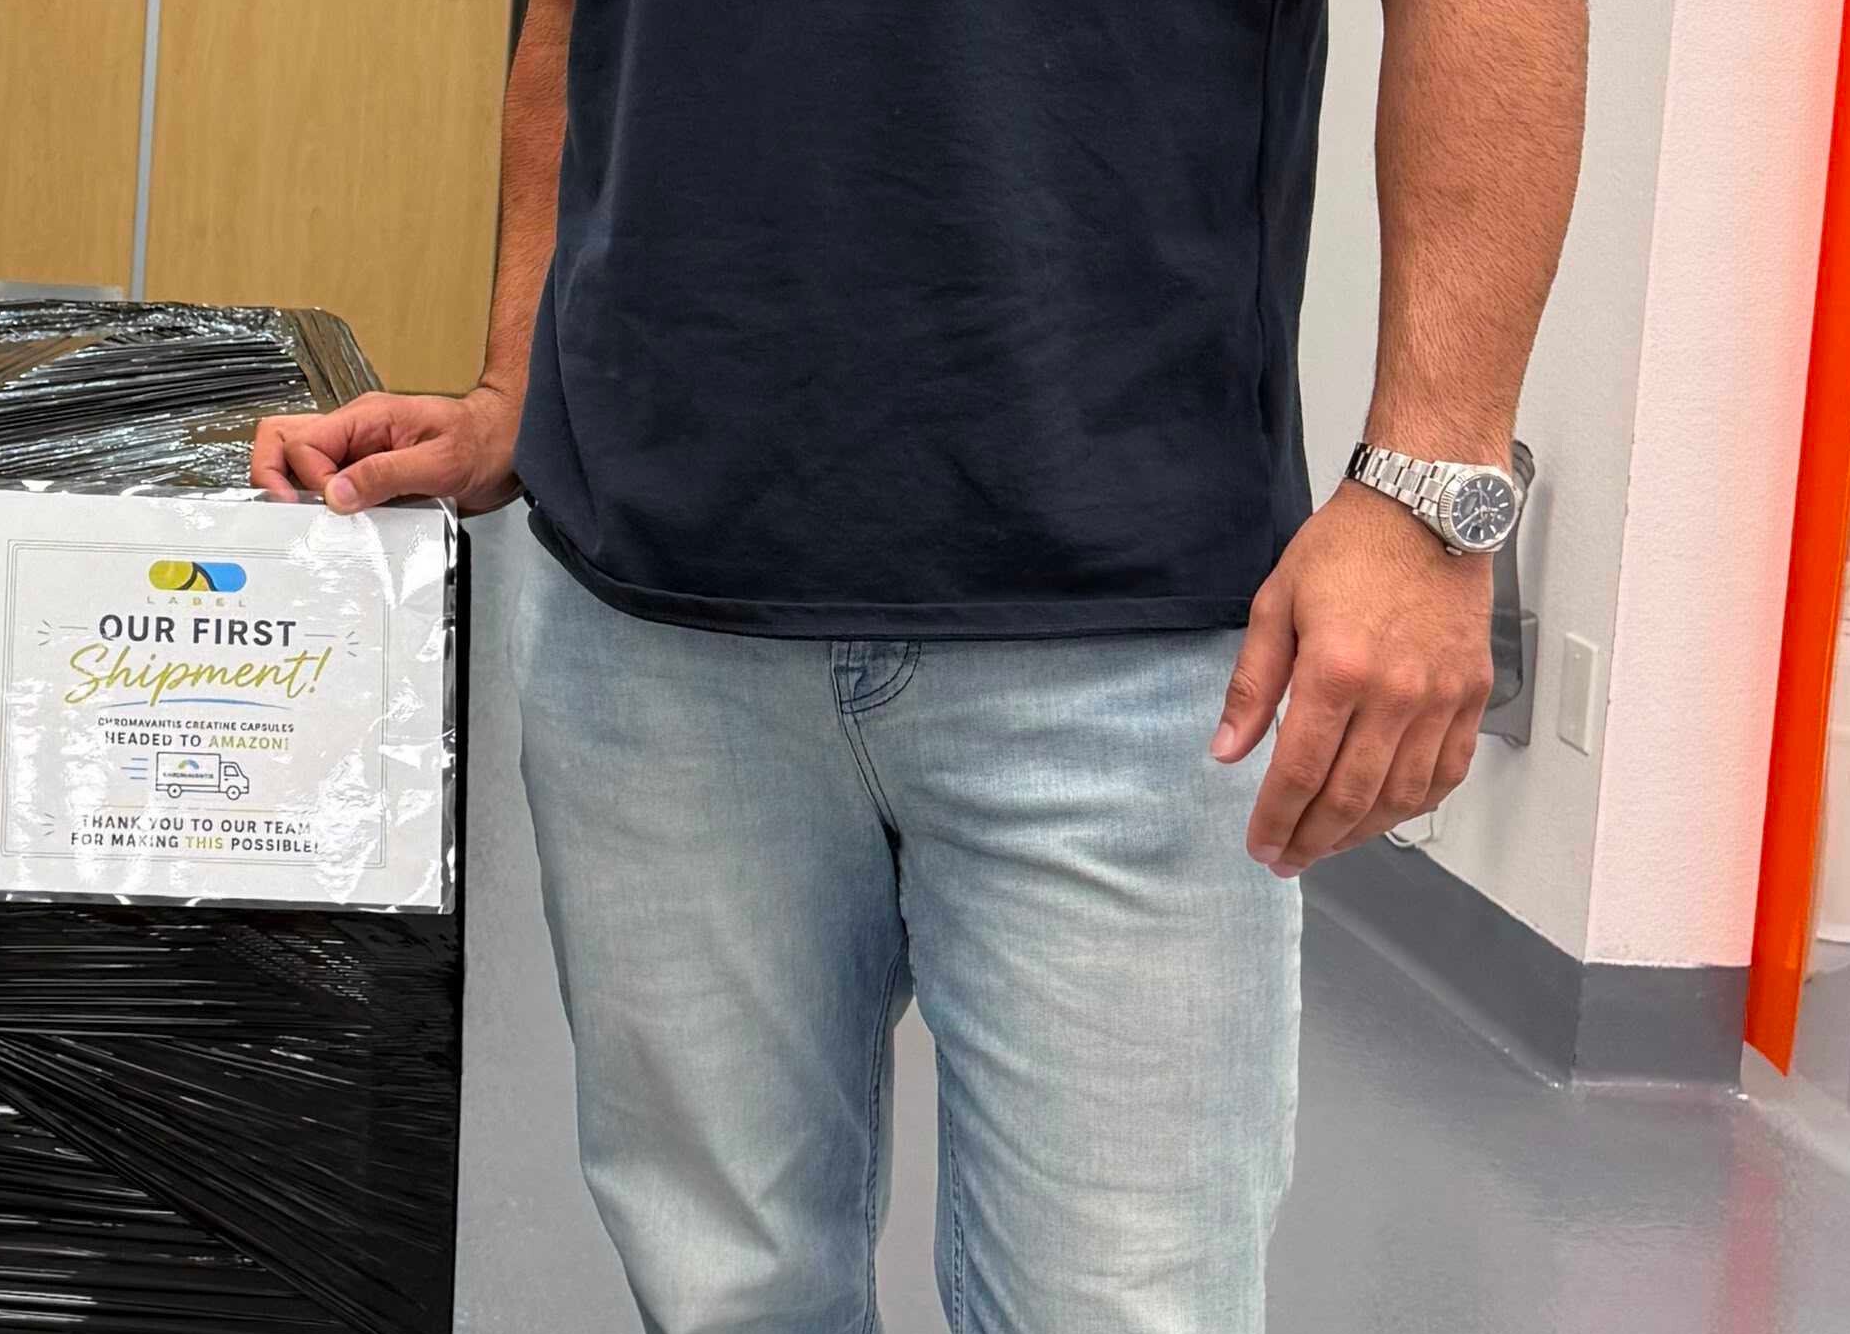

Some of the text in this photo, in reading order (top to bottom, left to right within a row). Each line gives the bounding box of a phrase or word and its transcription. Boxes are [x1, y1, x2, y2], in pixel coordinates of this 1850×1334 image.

[99, 614, 297, 646] OUR FIRST
[64, 642, 333, 707] Shipment!
[97, 717, 295, 733] CHROMAVANTIS CREATINE CAPSULES
[105, 731, 172, 746] HEADED
[180, 734, 202, 747] TO
[82, 815, 311, 835] THANK YOU TO OUR TEAM
[71, 832, 319, 854] FOR MAKING THIS POSSIBLE!
